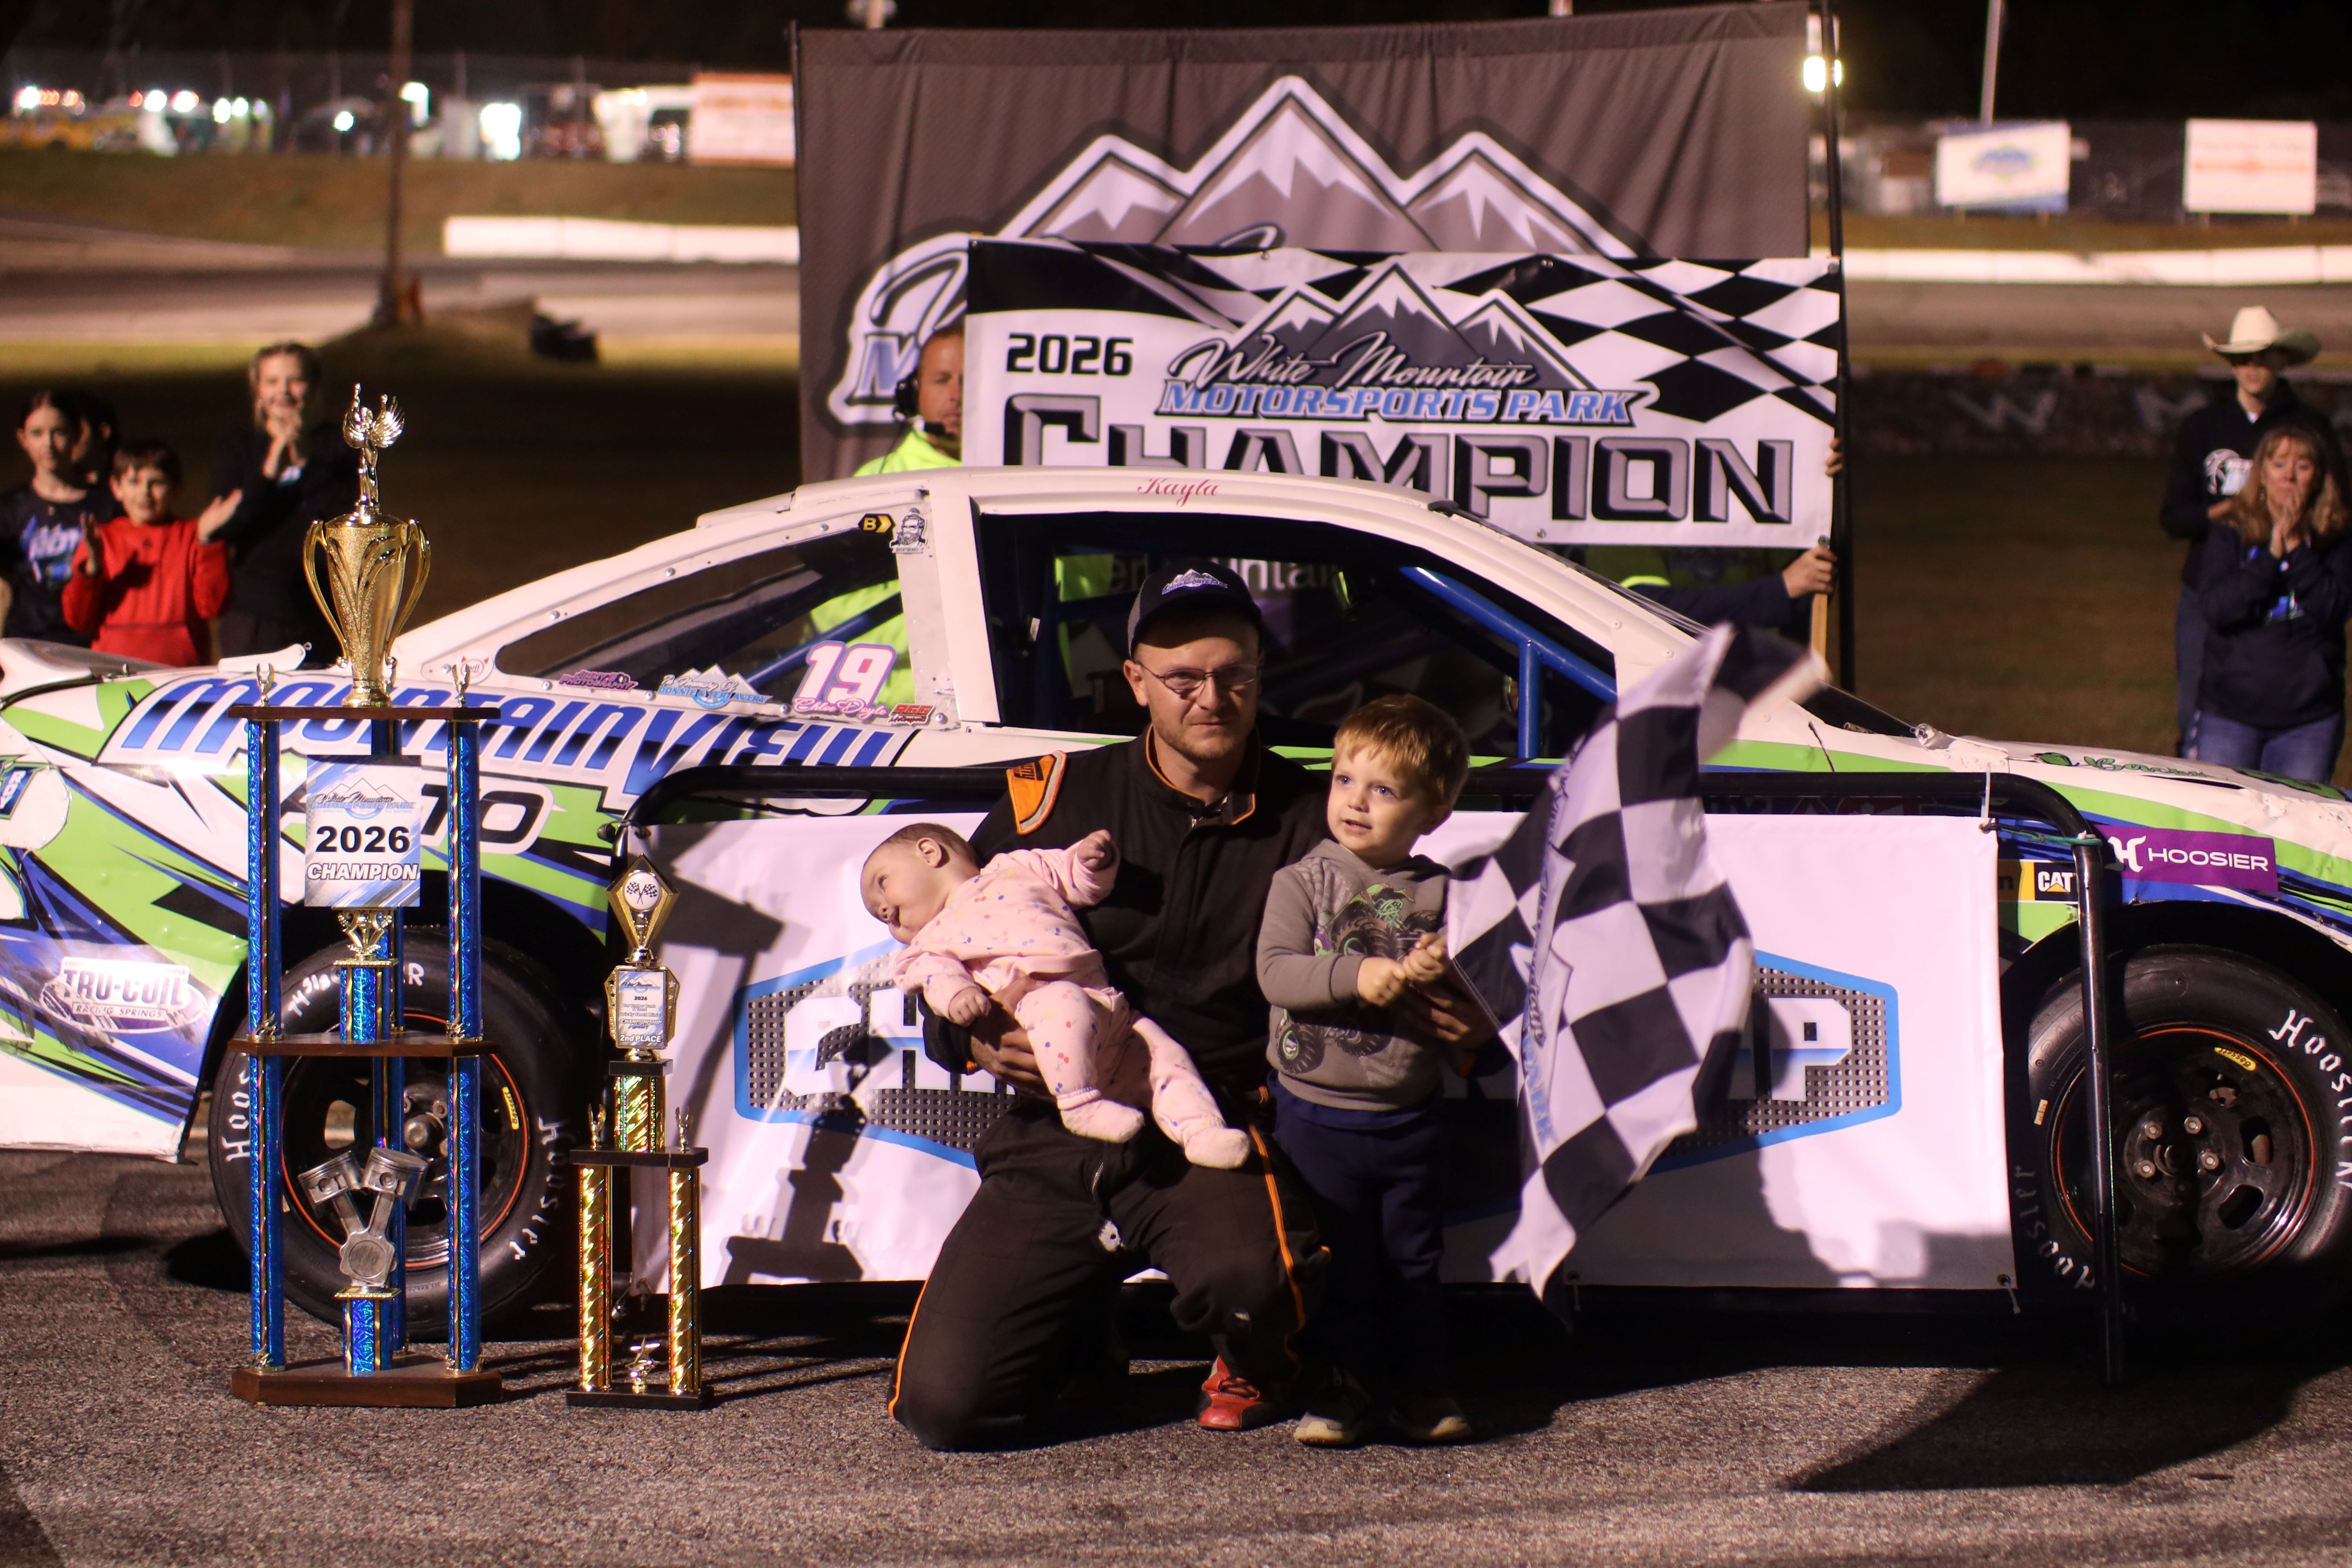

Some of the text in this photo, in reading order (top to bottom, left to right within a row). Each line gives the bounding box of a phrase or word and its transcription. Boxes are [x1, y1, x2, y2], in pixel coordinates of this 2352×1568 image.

[1006, 332, 1133, 378] 2026
[1169, 331, 1538, 391] White Mountain
[1160, 380, 1644, 424] MOTORSPORTS PARK
[1137, 476, 1220, 507] Kayla
[677, 676, 719, 692] Memory
[795, 641, 897, 707] 19
[658, 686, 696, 696] DONNIE
[732, 693, 768, 704] AVERY
[792, 697, 889, 720] Chloe Doyle
[313, 791, 395, 803] White Mountain
[315, 826, 411, 853] 2026
[307, 863, 419, 880] CHAMPION
[2147, 847, 2269, 872] HOOSIER
[2037, 871, 2074, 893] CAT
[63, 969, 185, 1007] TRU-COIL
[118, 1008, 163, 1018] SPRINGS
[635, 1035, 662, 1043] PLACE
